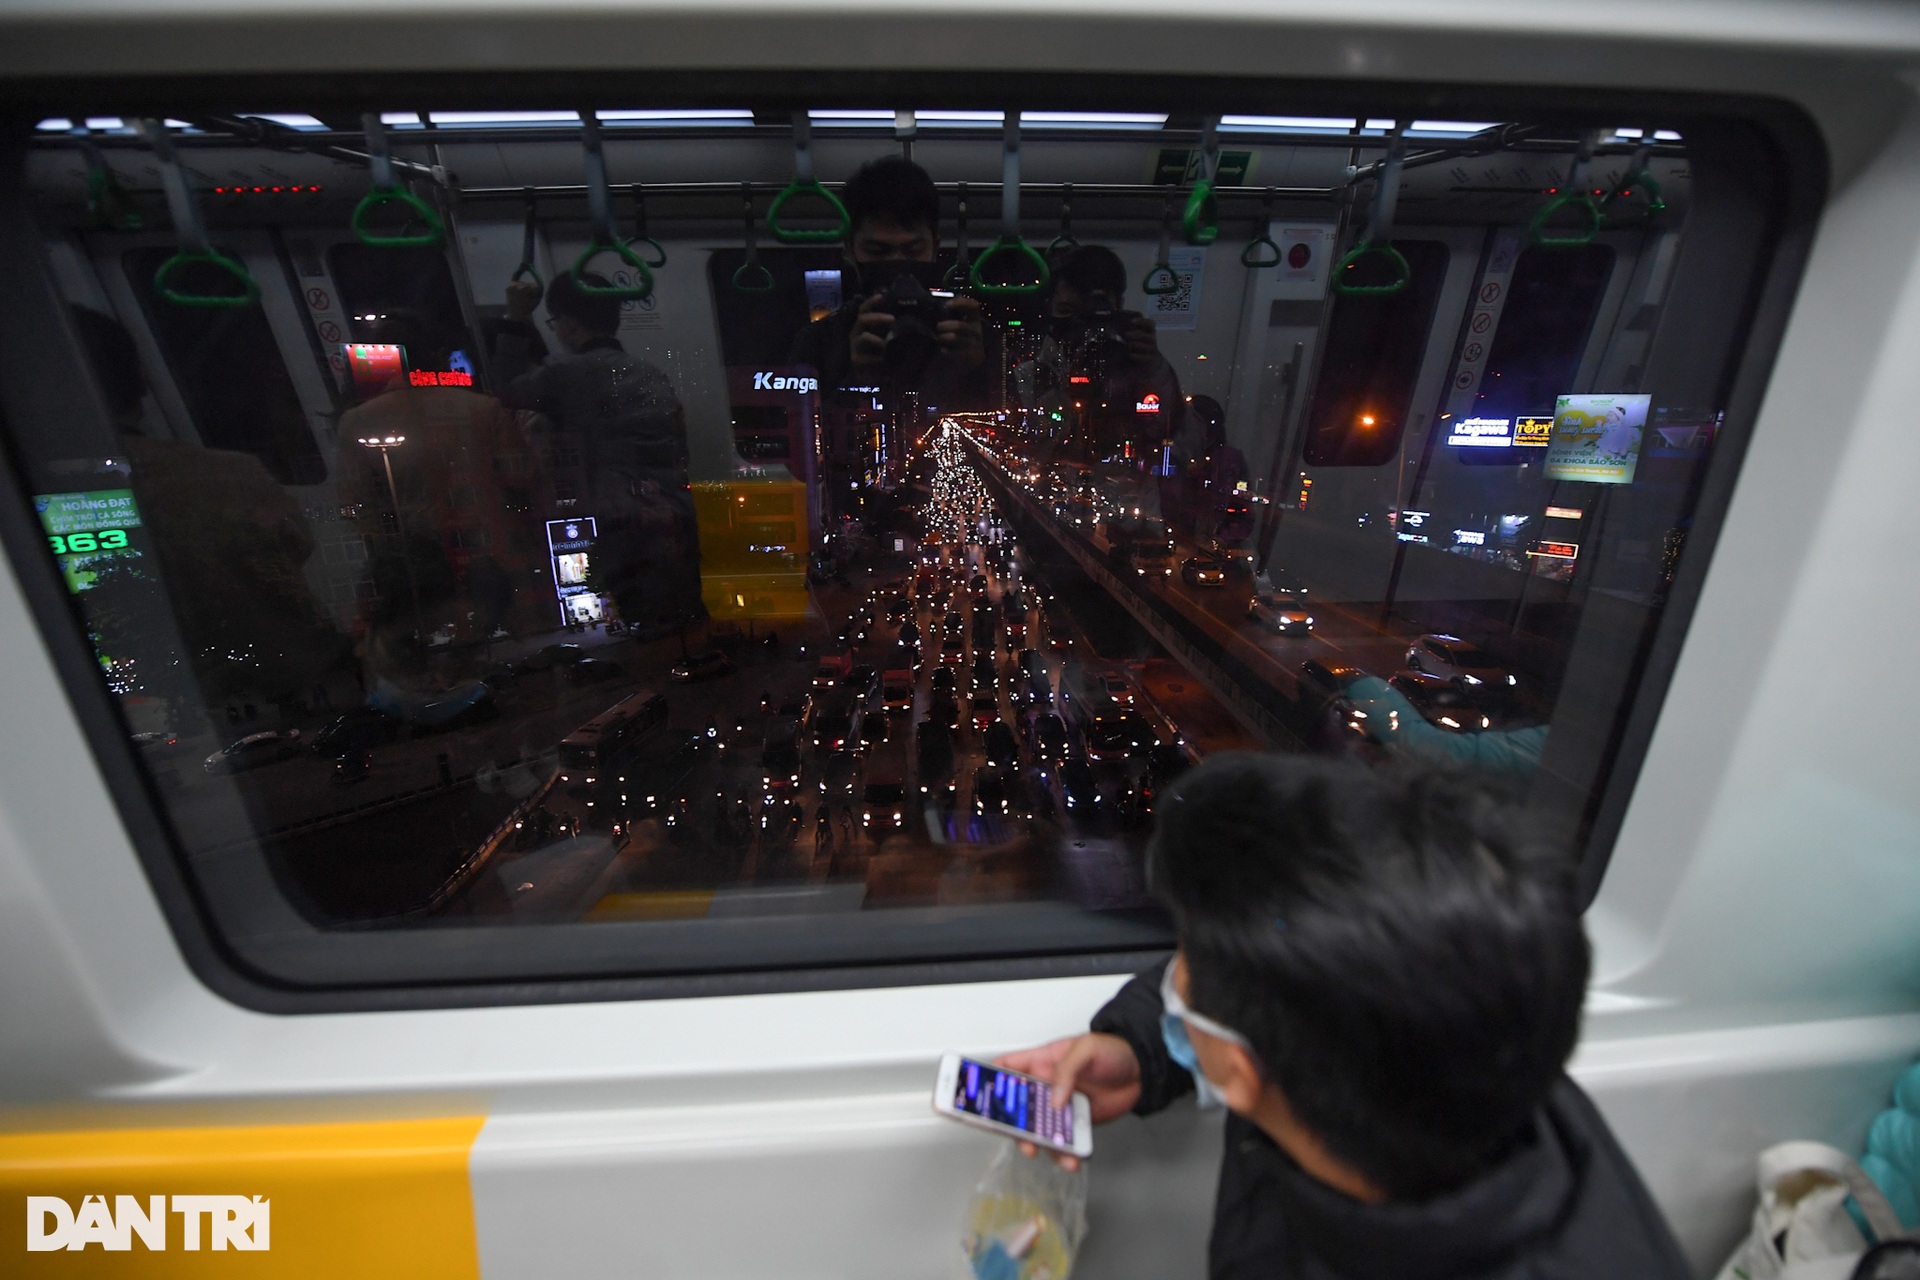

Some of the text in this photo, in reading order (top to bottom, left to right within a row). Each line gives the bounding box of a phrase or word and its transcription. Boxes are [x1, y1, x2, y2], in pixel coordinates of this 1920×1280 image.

[61, 498, 132, 511] HOÀNG ĐẠT
[50, 515, 75, 523] CHIM
[112, 509, 136, 517] SÔNG
